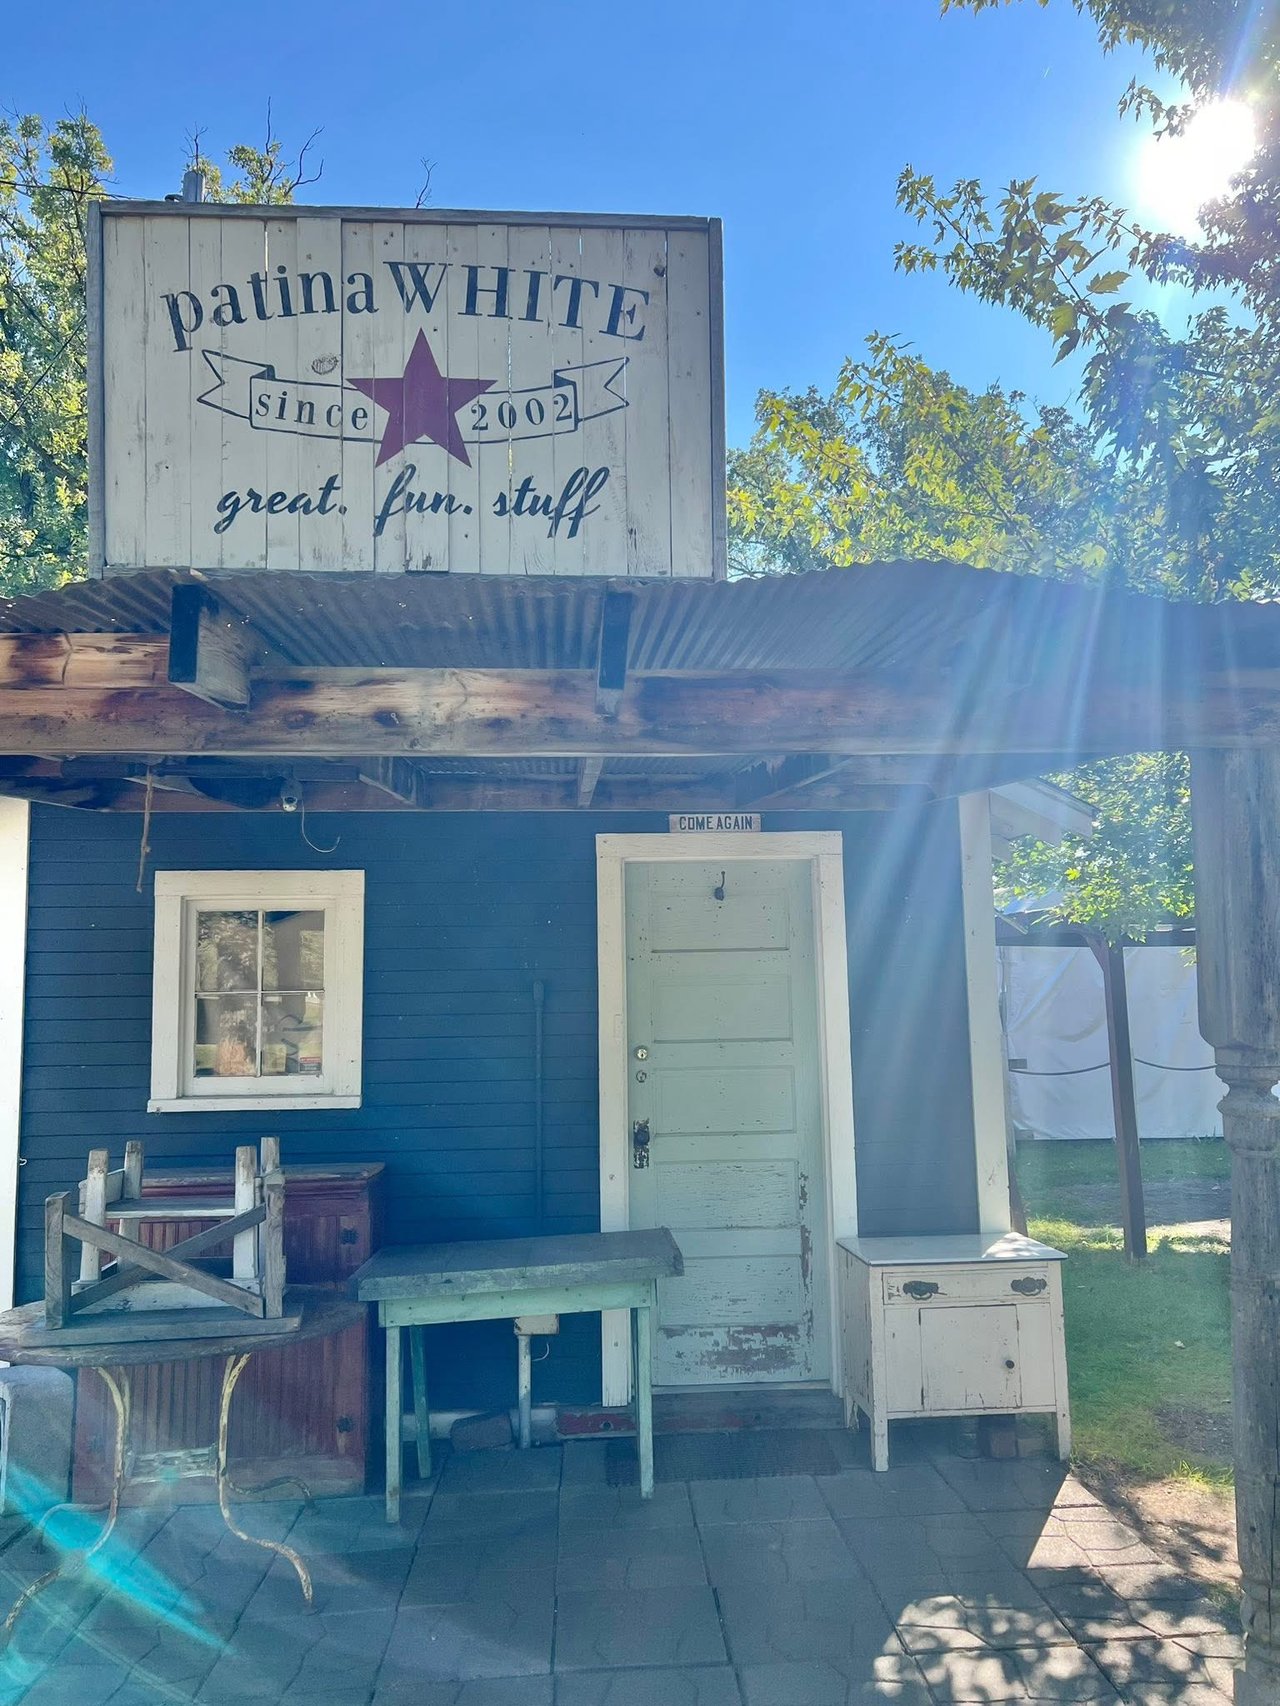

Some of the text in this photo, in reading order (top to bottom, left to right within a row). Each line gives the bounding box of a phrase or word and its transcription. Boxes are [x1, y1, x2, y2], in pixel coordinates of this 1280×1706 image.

[254, 388, 574, 431] since 2002
[213, 464, 611, 538] great. fun. stuff
[679, 815, 753, 830] COME AGAIN
